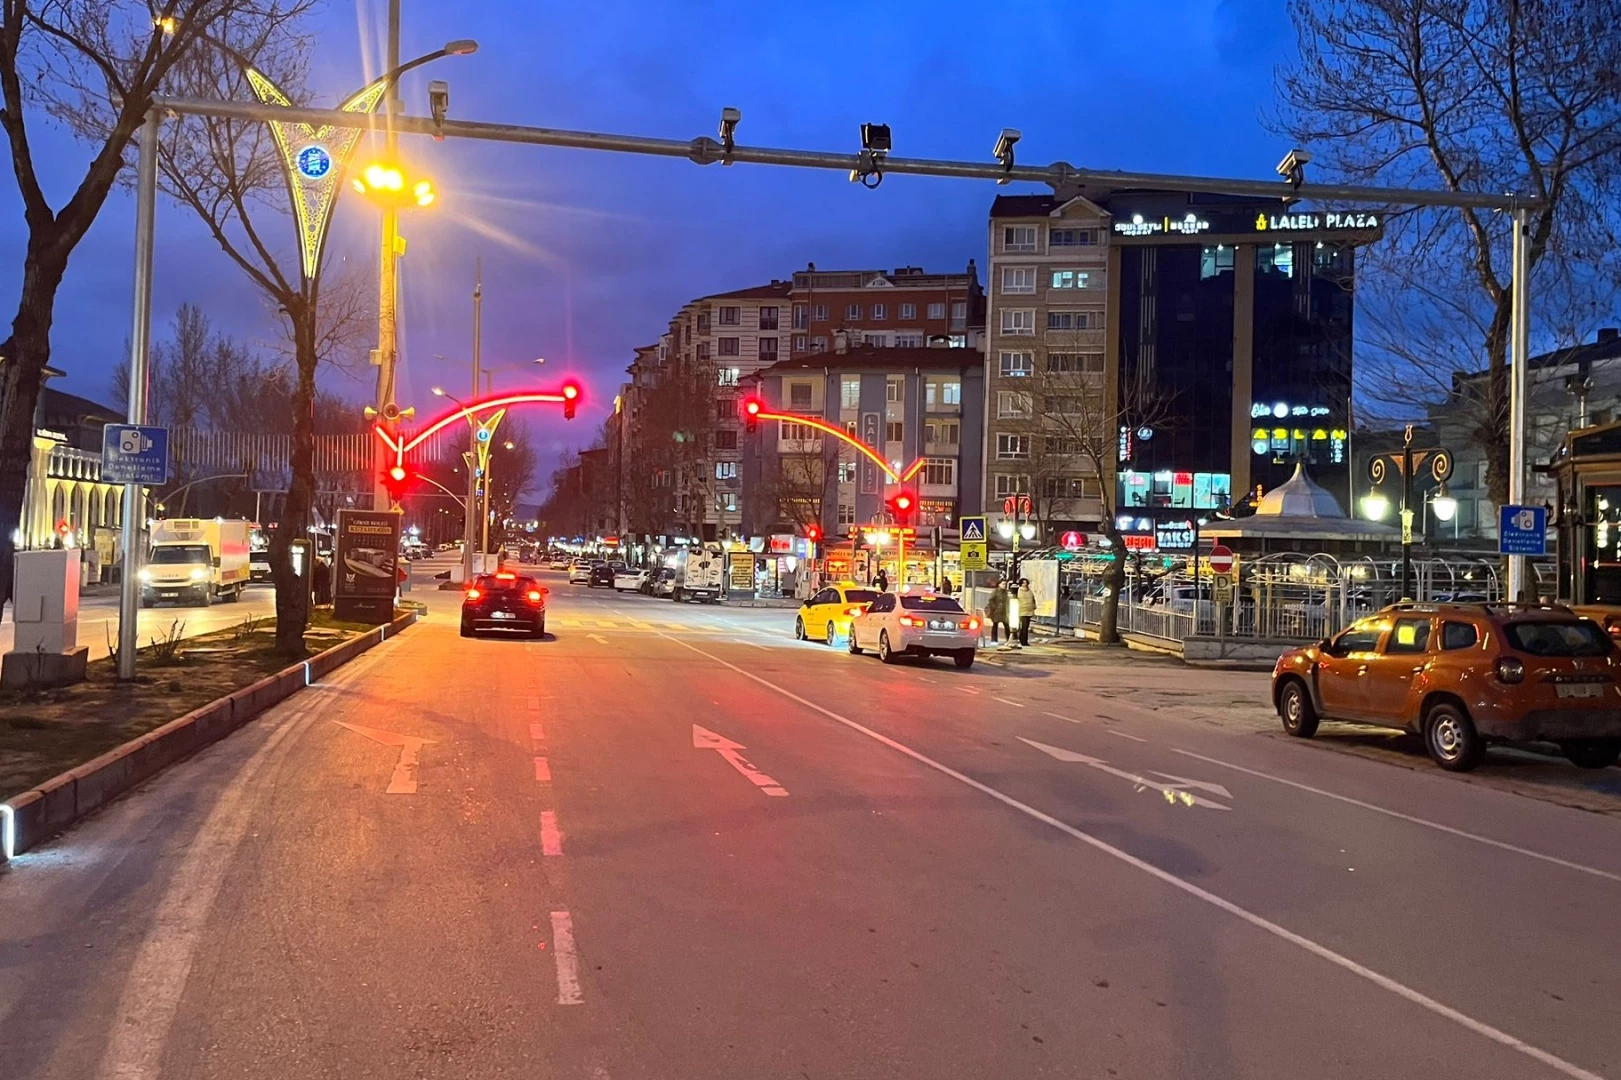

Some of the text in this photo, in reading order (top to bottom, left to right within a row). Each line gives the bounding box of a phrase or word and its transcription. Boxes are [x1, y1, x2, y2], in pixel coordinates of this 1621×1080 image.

[1326, 214, 1378, 229] PLAZA
[1253, 428, 1347, 441] ASLAN
[110, 453, 161, 463] Elektronik
[109, 463, 161, 472] Denetleme
[1217, 576, 1228, 588] D
